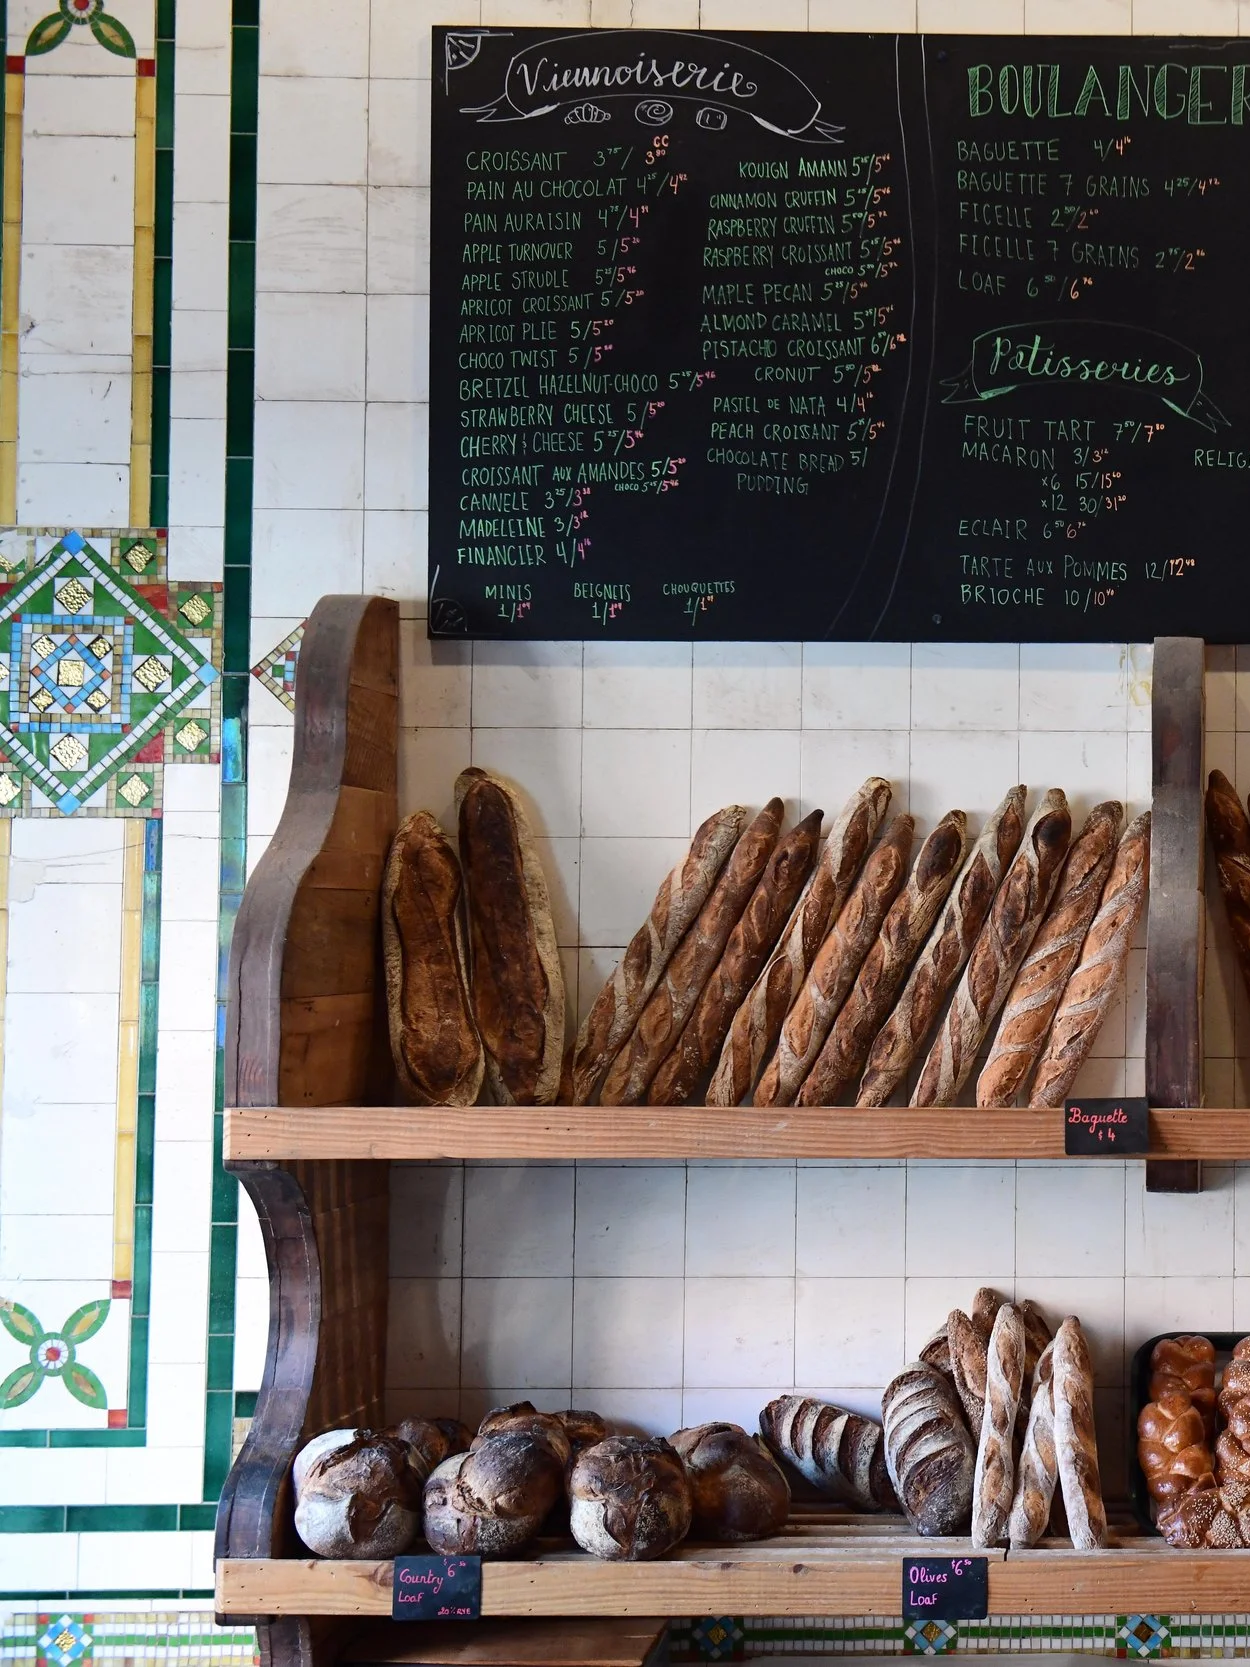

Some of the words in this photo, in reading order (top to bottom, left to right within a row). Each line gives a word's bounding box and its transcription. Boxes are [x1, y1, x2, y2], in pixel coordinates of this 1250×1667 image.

[517, 53, 757, 99] Viennoiserie
[467, 150, 567, 172] CROISSANT
[958, 139, 1059, 162] BAGUETTE
[740, 161, 788, 179] KOUIGN
[799, 157, 847, 178] AMANN
[467, 181, 504, 200] PAIN
[512, 181, 532, 201] AU
[541, 178, 627, 198] CHOCOLAT
[958, 170, 1046, 195] BAGUETTE
[1060, 174, 1072, 196] 7
[1087, 176, 1149, 198] GRAINS
[710, 192, 777, 210] CINNAMON
[785, 188, 836, 208] CRUFFIN
[465, 213, 497, 232] PAIN
[960, 202, 1031, 228] FICELLE
[708, 217, 777, 240] RASPBERRY
[784, 215, 835, 235] CRUFFIN
[463, 244, 502, 263] APPLE
[508, 242, 572, 261] TURNOVER
[704, 245, 773, 268] RASPBERRY
[782, 241, 852, 265] CROISSANT
[960, 234, 1033, 260] FICELLE
[1047, 240, 1058, 261] 7
[1072, 242, 1138, 268] GRAINS
[462, 273, 502, 291] APPLE
[512, 269, 568, 289] STRUDLE
[825, 266, 853, 276] CHOCO
[703, 284, 753, 304] MAPLE
[763, 283, 812, 304] PECAN
[959, 270, 1005, 295] LOAF
[461, 299, 512, 316] APRICOT
[523, 293, 593, 313] CROISSANT
[459, 324, 515, 343] APRICOT
[523, 321, 556, 340] PLIE
[700, 312, 767, 333] ALMOND
[772, 312, 842, 332] CARAMEL
[459, 352, 504, 369] CHOCO
[510, 350, 557, 368] TWIST
[788, 337, 865, 360] CROISSANT
[990, 335, 1190, 385] Patisseries
[755, 367, 820, 383] CRONUT
[460, 376, 529, 401] BRETZEL
[461, 404, 553, 427] STRAWBERRY
[564, 404, 613, 424] CHEESE
[714, 397, 759, 413] PASTEL
[768, 399, 780, 409] DE
[789, 396, 825, 416] NATA
[711, 423, 753, 439] PEACH
[764, 423, 839, 442] CROISSANT
[965, 414, 1030, 440] FRUIT
[1044, 419, 1095, 441] TART
[461, 434, 516, 458] CHERRY
[533, 432, 584, 452] CHEESE
[963, 442, 1054, 470] MACARON
[707, 448, 788, 470] CHOCOLATE
[799, 453, 844, 473] BREAD
[462, 465, 544, 486] CROISSANT
[553, 466, 571, 481] AUX
[577, 462, 644, 484] AMANDES
[738, 473, 808, 495] PUDDING
[615, 483, 639, 491] CHOCO
[460, 492, 528, 512] CANNELE
[460, 517, 545, 539] MADELEINE
[959, 519, 1027, 540] ECLAIR
[457, 545, 546, 566] FINANCIER
[960, 555, 1012, 578] TARTE
[1065, 555, 1127, 581] POMMES
[486, 584, 531, 601] MINIS
[574, 583, 630, 602] BEIGNETS
[663, 581, 735, 595] CHOUQUETTES
[961, 584, 1044, 605] BRIOCHE
[1068, 1107, 1127, 1133] Baguette
[399, 1569, 443, 1596] Country
[910, 1566, 947, 1583] Olives
